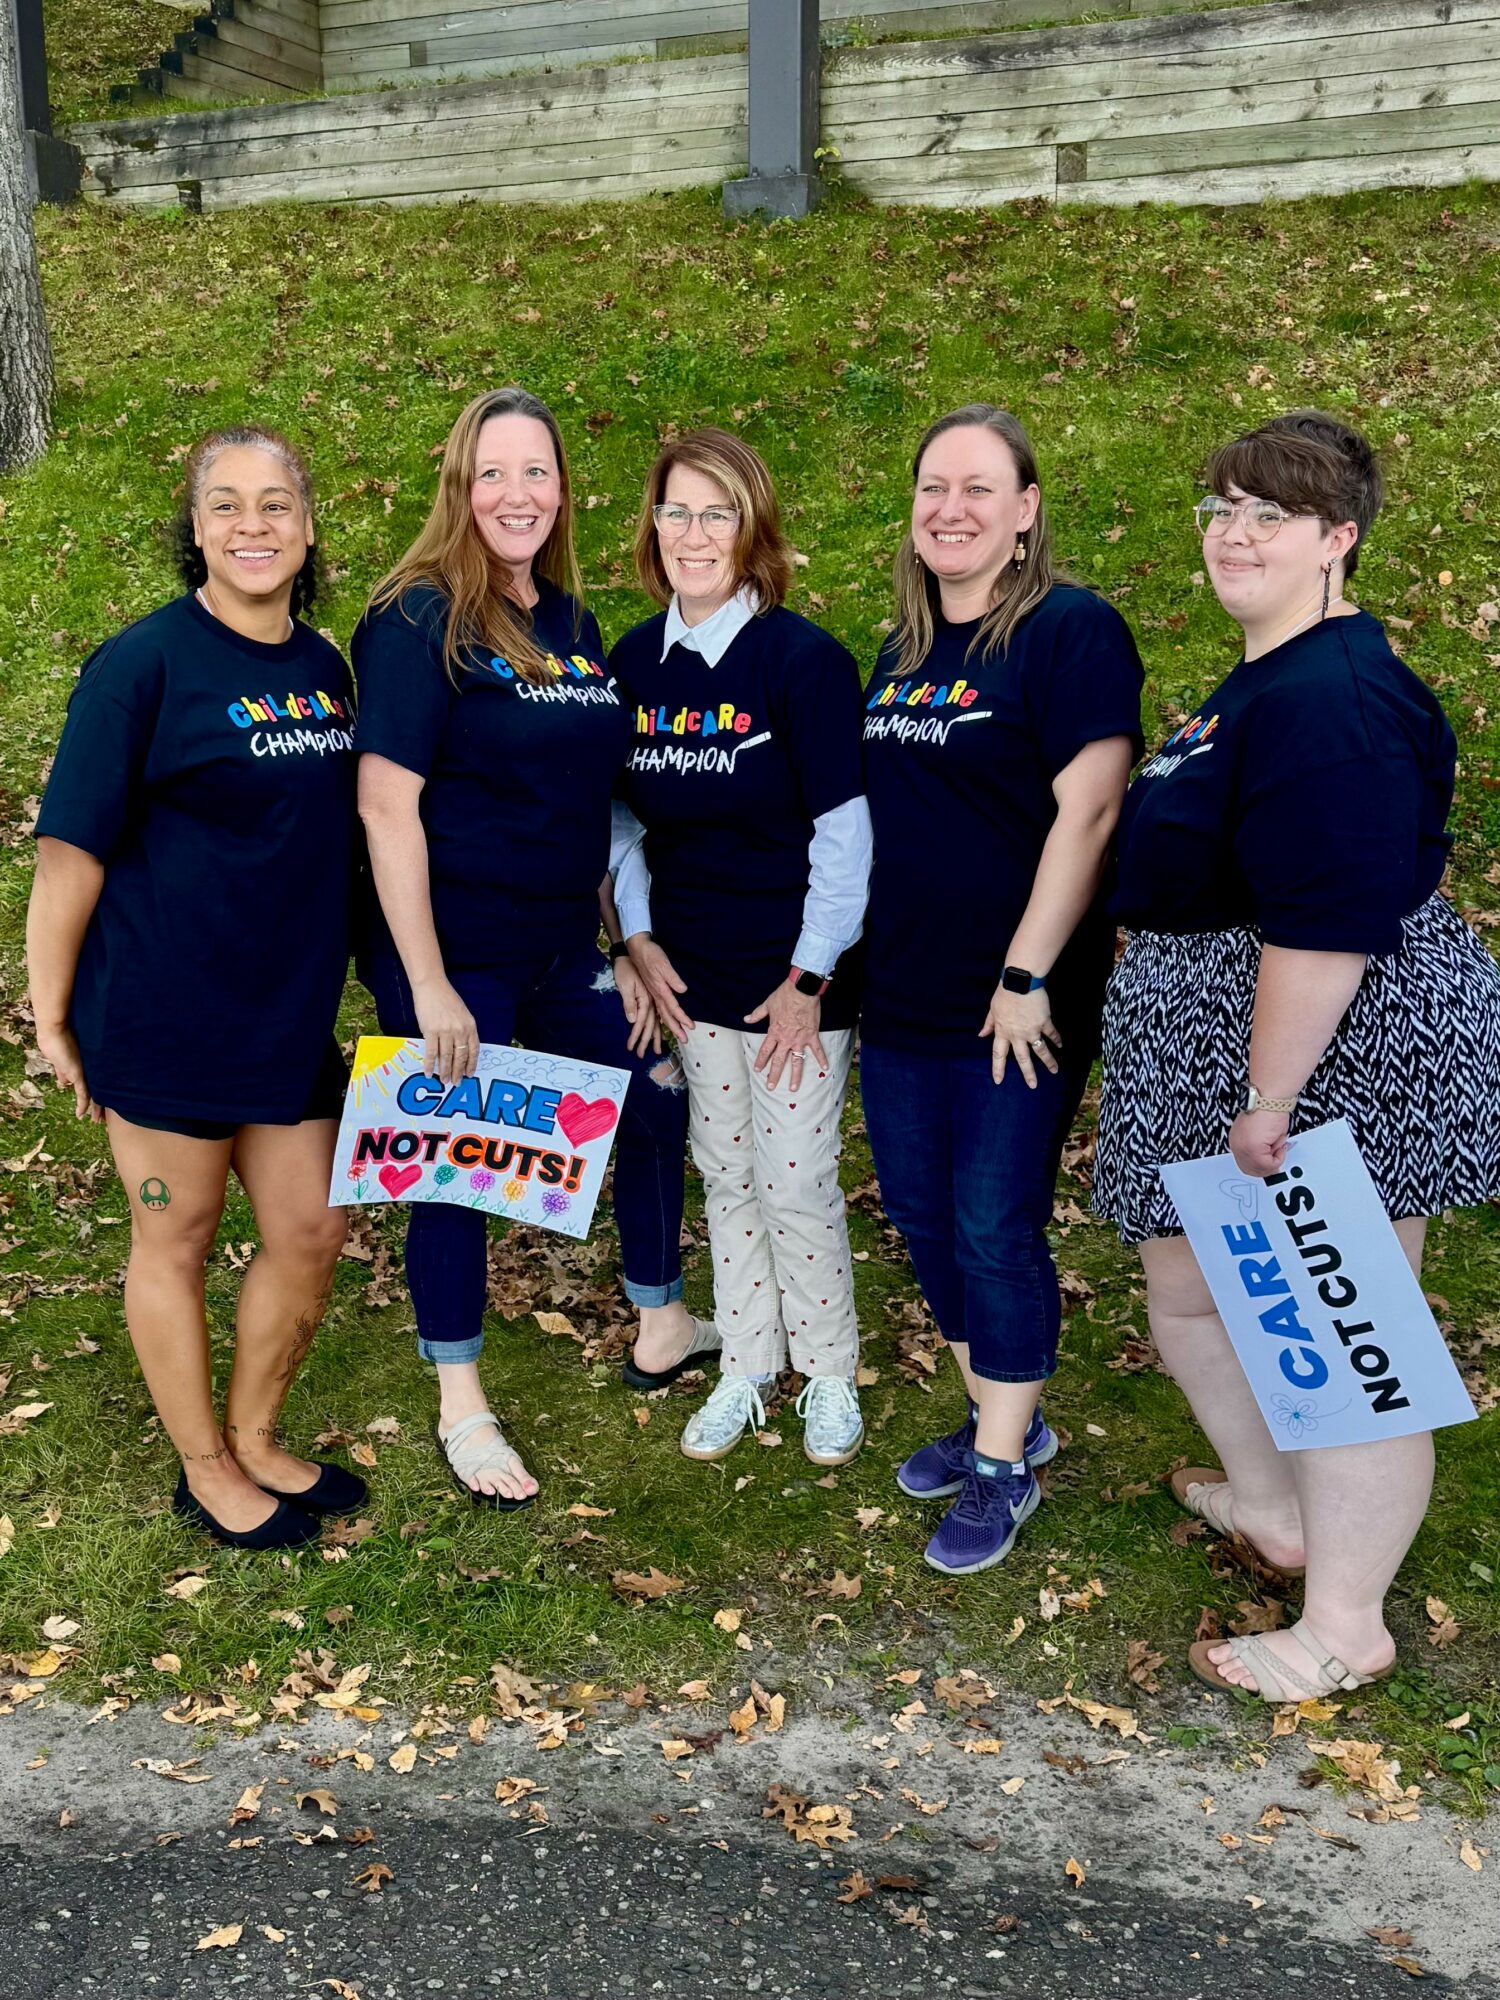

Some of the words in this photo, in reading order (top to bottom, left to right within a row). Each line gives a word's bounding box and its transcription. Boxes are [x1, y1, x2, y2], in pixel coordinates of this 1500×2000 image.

[515, 678, 620, 707] CHAMPION
[632, 703, 752, 737] hiLdcARe
[863, 714, 953, 746] HAMPION
[396, 1072, 562, 1135] CARE
[354, 1128, 450, 1164] NOT
[448, 1134, 587, 1193] CUTS!
[1263, 1165, 1358, 1308] CUTS!
[1220, 1221, 1329, 1390] CARE
[1332, 1319, 1411, 1414] NOT
